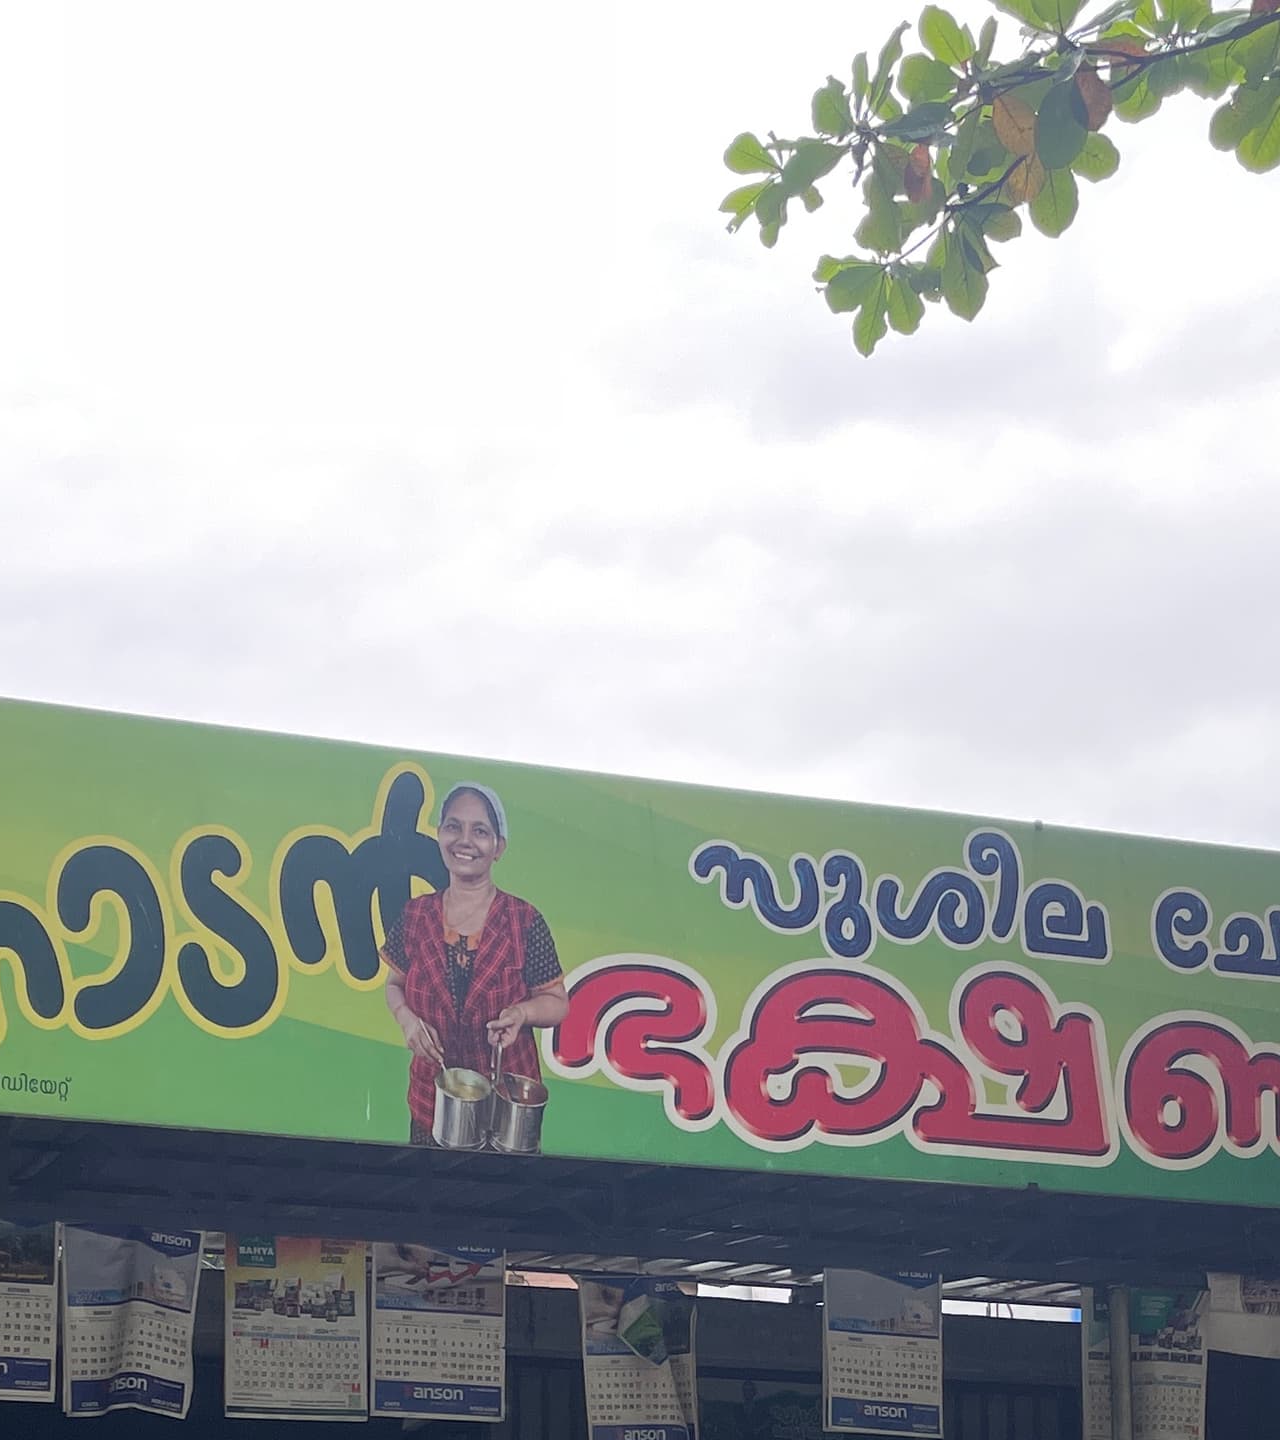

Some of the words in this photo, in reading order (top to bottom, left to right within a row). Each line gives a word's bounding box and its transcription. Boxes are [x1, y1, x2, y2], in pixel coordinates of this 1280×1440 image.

[691, 829, 1110, 962] സുശീല
[151, 1231, 192, 1248] anson
[655, 1281, 682, 1294] anso
[105, 1374, 148, 1392] nson
[413, 1386, 464, 1401] anson
[863, 1403, 908, 1419] anson
